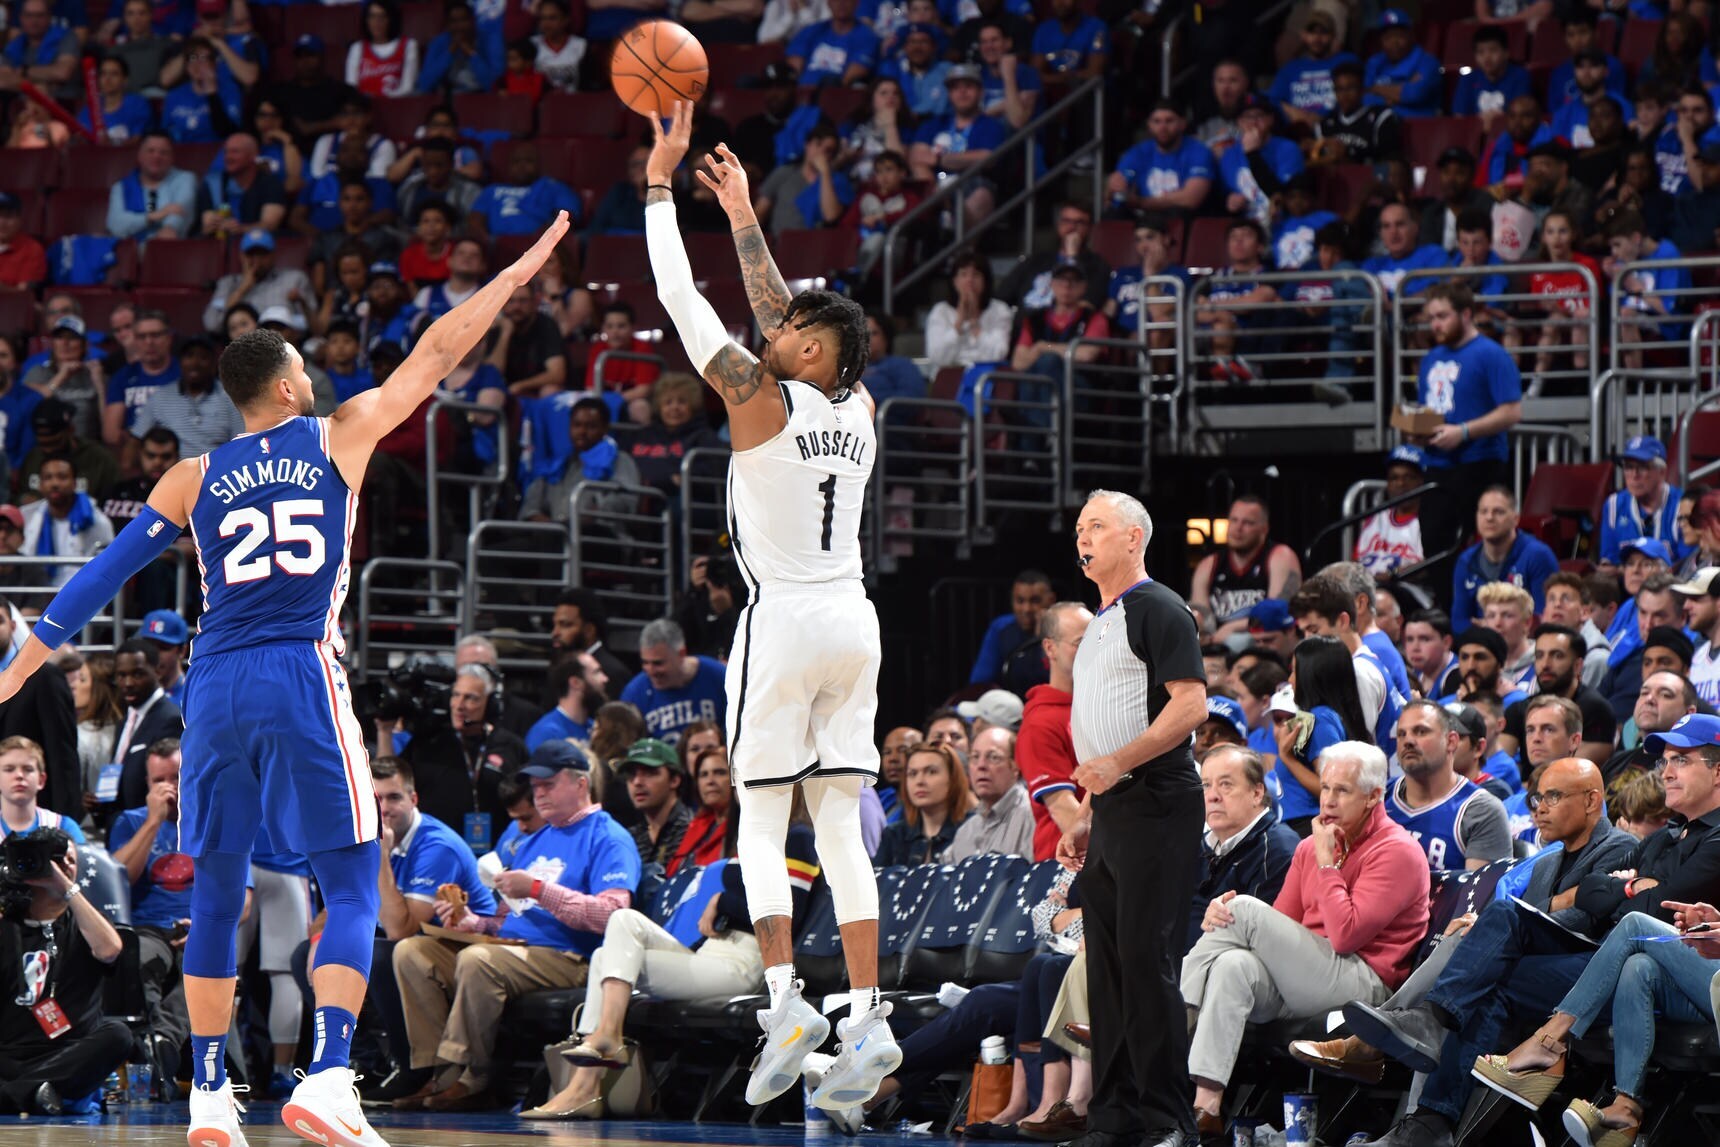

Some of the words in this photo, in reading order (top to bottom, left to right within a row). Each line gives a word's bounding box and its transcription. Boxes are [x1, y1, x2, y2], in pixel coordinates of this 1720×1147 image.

[795, 430, 866, 466] RUSSELL
[209, 458, 324, 504] SIMMONS
[218, 499, 326, 586] 25
[818, 473, 837, 552] 1
